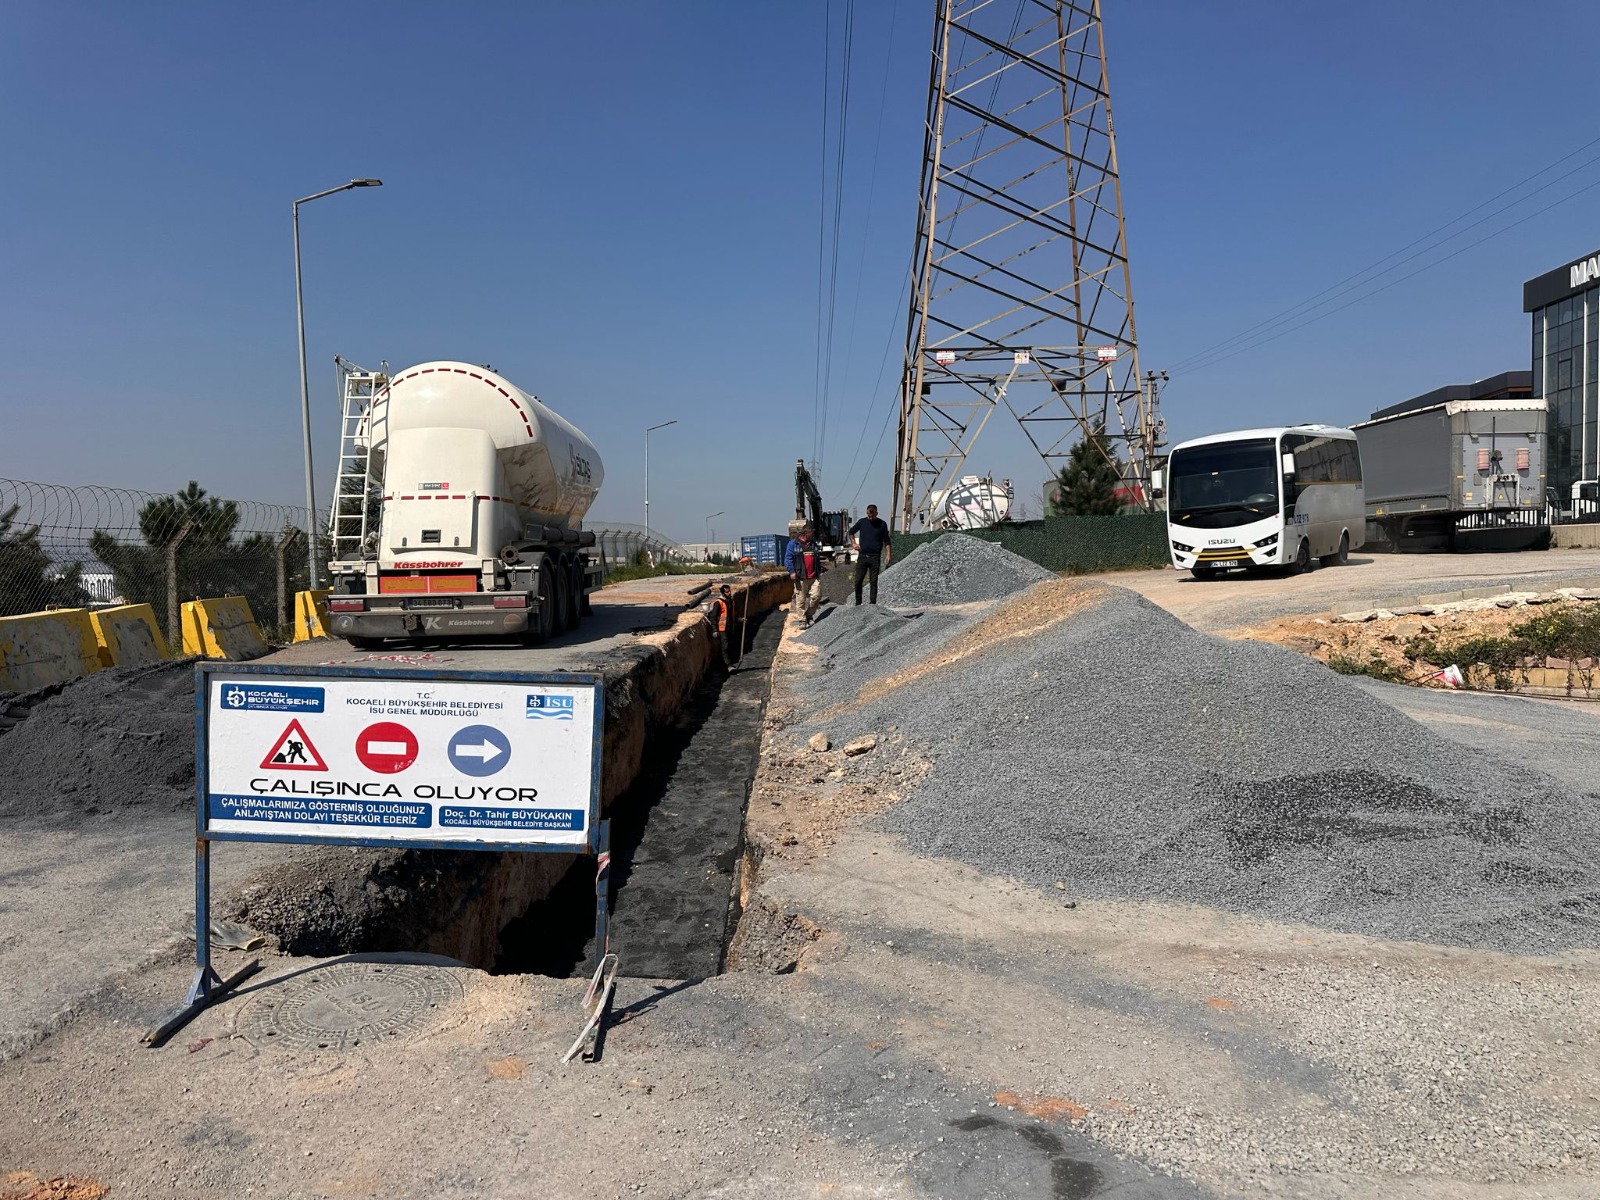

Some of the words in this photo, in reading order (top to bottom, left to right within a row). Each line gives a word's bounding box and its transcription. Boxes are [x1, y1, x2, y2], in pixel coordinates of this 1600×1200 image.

[1570, 254, 1600, 288] MA
[248, 697, 320, 706] BÜYÜKŞEHİR
[389, 699, 447, 708] BÜYÜKŞEHİR
[450, 701, 503, 709] BELEDİYESİ
[546, 697, 572, 708] İSU
[420, 708, 478, 717] MÜDÜRLÜĞÜ
[250, 778, 402, 797] ÇALIŞINCA
[414, 785, 538, 801] OLUYOR
[221, 798, 306, 809] ÇALIŞMALARIMIZA
[309, 801, 363, 812] GÖSTERMİŞ
[367, 804, 425, 814] OLDUĞUNUZ
[234, 810, 292, 820] ANLAYIŞTAN
[294, 812, 328, 821] DOLAYI
[330, 812, 381, 823] TEŞEKKÜR
[383, 814, 417, 825] EDERİZ
[445, 809, 466, 818] Doç.
[485, 811, 509, 819] Tahir
[512, 810, 572, 820] BÜYÜKAKIN
